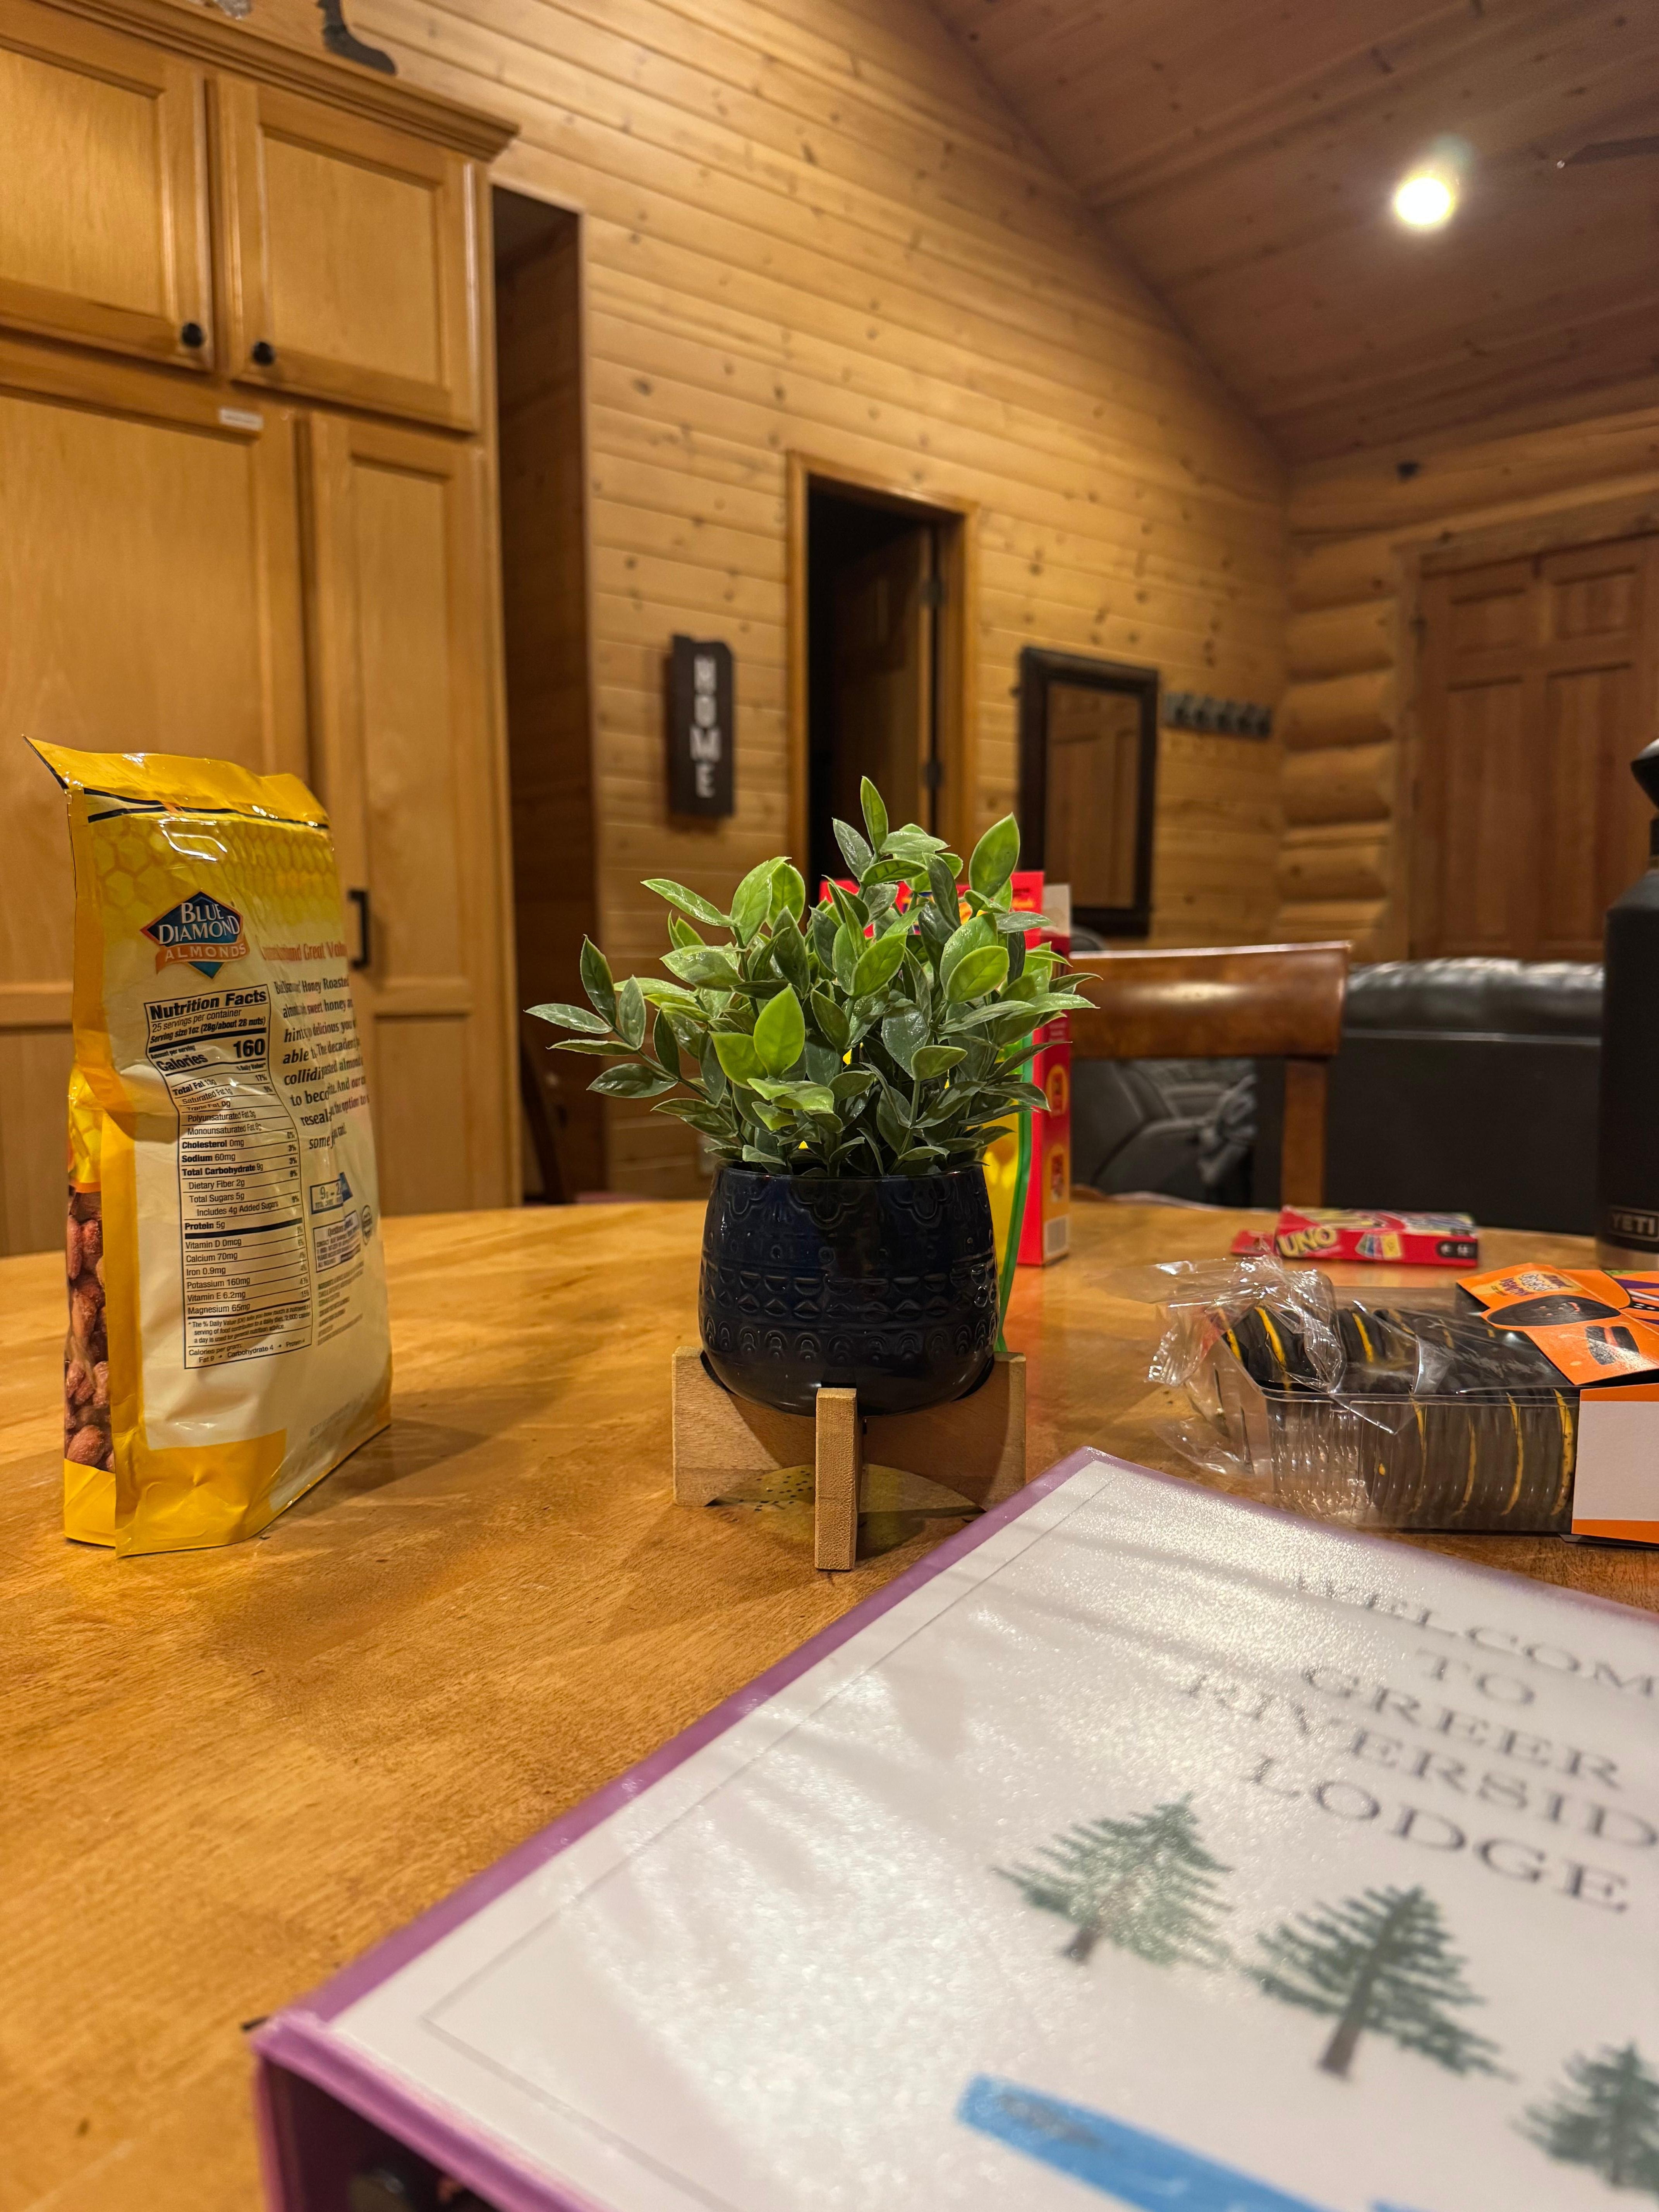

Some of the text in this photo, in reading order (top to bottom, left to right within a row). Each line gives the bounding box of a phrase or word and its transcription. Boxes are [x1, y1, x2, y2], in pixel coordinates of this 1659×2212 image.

[181, 902, 224, 924] BLUE
[159, 915, 240, 945] DIAMOND
[165, 943, 246, 962] ALMONDS
[302, 980, 321, 994] Honey
[150, 990, 267, 1020] Nutrition Facts
[324, 999, 346, 1012] honey
[152, 1008, 242, 1033] 25 servings per container
[150, 1031, 173, 1044] Serving
[175, 1027, 187, 1036] size
[238, 1018, 247, 1027] 28
[249, 1016, 266, 1026] nuts)
[156, 1038, 266, 1072] Calories 160
[283, 1048, 309, 1064] able
[173, 1084, 193, 1096] Total
[194, 1080, 205, 1089] Fat
[182, 1091, 216, 1104] Saturated
[221, 1100, 231, 1108] 0g
[290, 1094, 302, 1106] to
[188, 1111, 241, 1123] Polyunsaturated
[241, 1110, 250, 1118] Fat
[187, 1124, 246, 1135] Monounsaturated
[182, 1139, 227, 1149] Cholesterol
[229, 1139, 244, 1147] 0mg
[182, 1154, 213, 1163] Sodium
[215, 1153, 236, 1162] 60mg
[182, 1167, 203, 1176] Total
[205, 1163, 256, 1176] Carbohydrate
[256, 1163, 264, 1171] 9g
[189, 1181, 215, 1191] Dietary
[216, 1180, 234, 1188] Fiber
[236, 1179, 245, 1188] 2g
[189, 1192, 245, 1204] Total Sugars 5g
[197, 1207, 227, 1217] Includes
[228, 1206, 238, 1215] 4g
[239, 1202, 260, 1212] Added
[261, 1201, 279, 1211] Sugars
[185, 1221, 225, 1230] Protein 5g
[1611, 1213, 1655, 1235] YETI
[185, 1240, 213, 1249] Vitamin
[222, 1238, 242, 1247] 0mcg
[1277, 1226, 1337, 1257] UNO
[186, 1254, 216, 1262] Calcium
[217, 1252, 238, 1261] 70mg
[187, 1268, 201, 1276] Iron
[202, 1266, 226, 1275] 0.9mg
[187, 1279, 225, 1289] Potassium
[227, 1277, 251, 1286] 160mg
[187, 1293, 215, 1302] Vitamin
[223, 1290, 246, 1299] 6.2mg
[187, 1305, 230, 1315] Magnesium
[232, 1304, 251, 1312] 65mg
[227, 1345, 269, 1358] Carbohydrate
[1415, 1647, 1536, 1705] TO
[1302, 1665, 1623, 1791] GREER
[1243, 1756, 1630, 1913] LODGE
